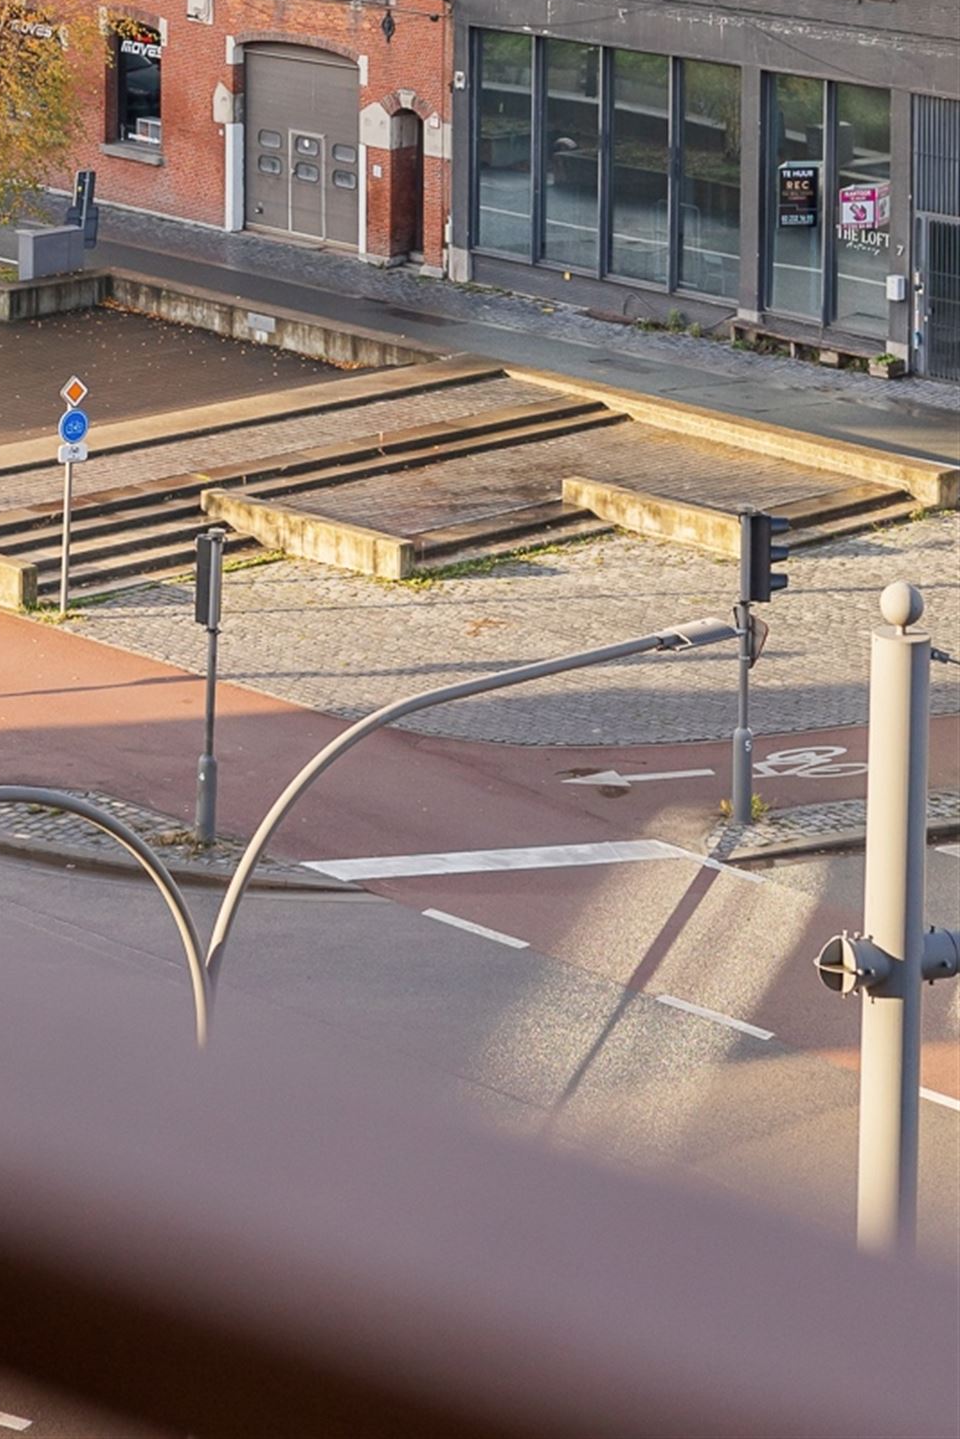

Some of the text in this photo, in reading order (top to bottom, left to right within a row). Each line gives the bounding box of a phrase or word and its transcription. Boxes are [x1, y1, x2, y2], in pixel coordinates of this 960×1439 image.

[782, 170, 814, 178] TE HUUR
[785, 180, 810, 190] REC
[836, 224, 890, 248] THE LOFT
[896, 244, 904, 257] 7
[744, 740, 752, 752] 5
